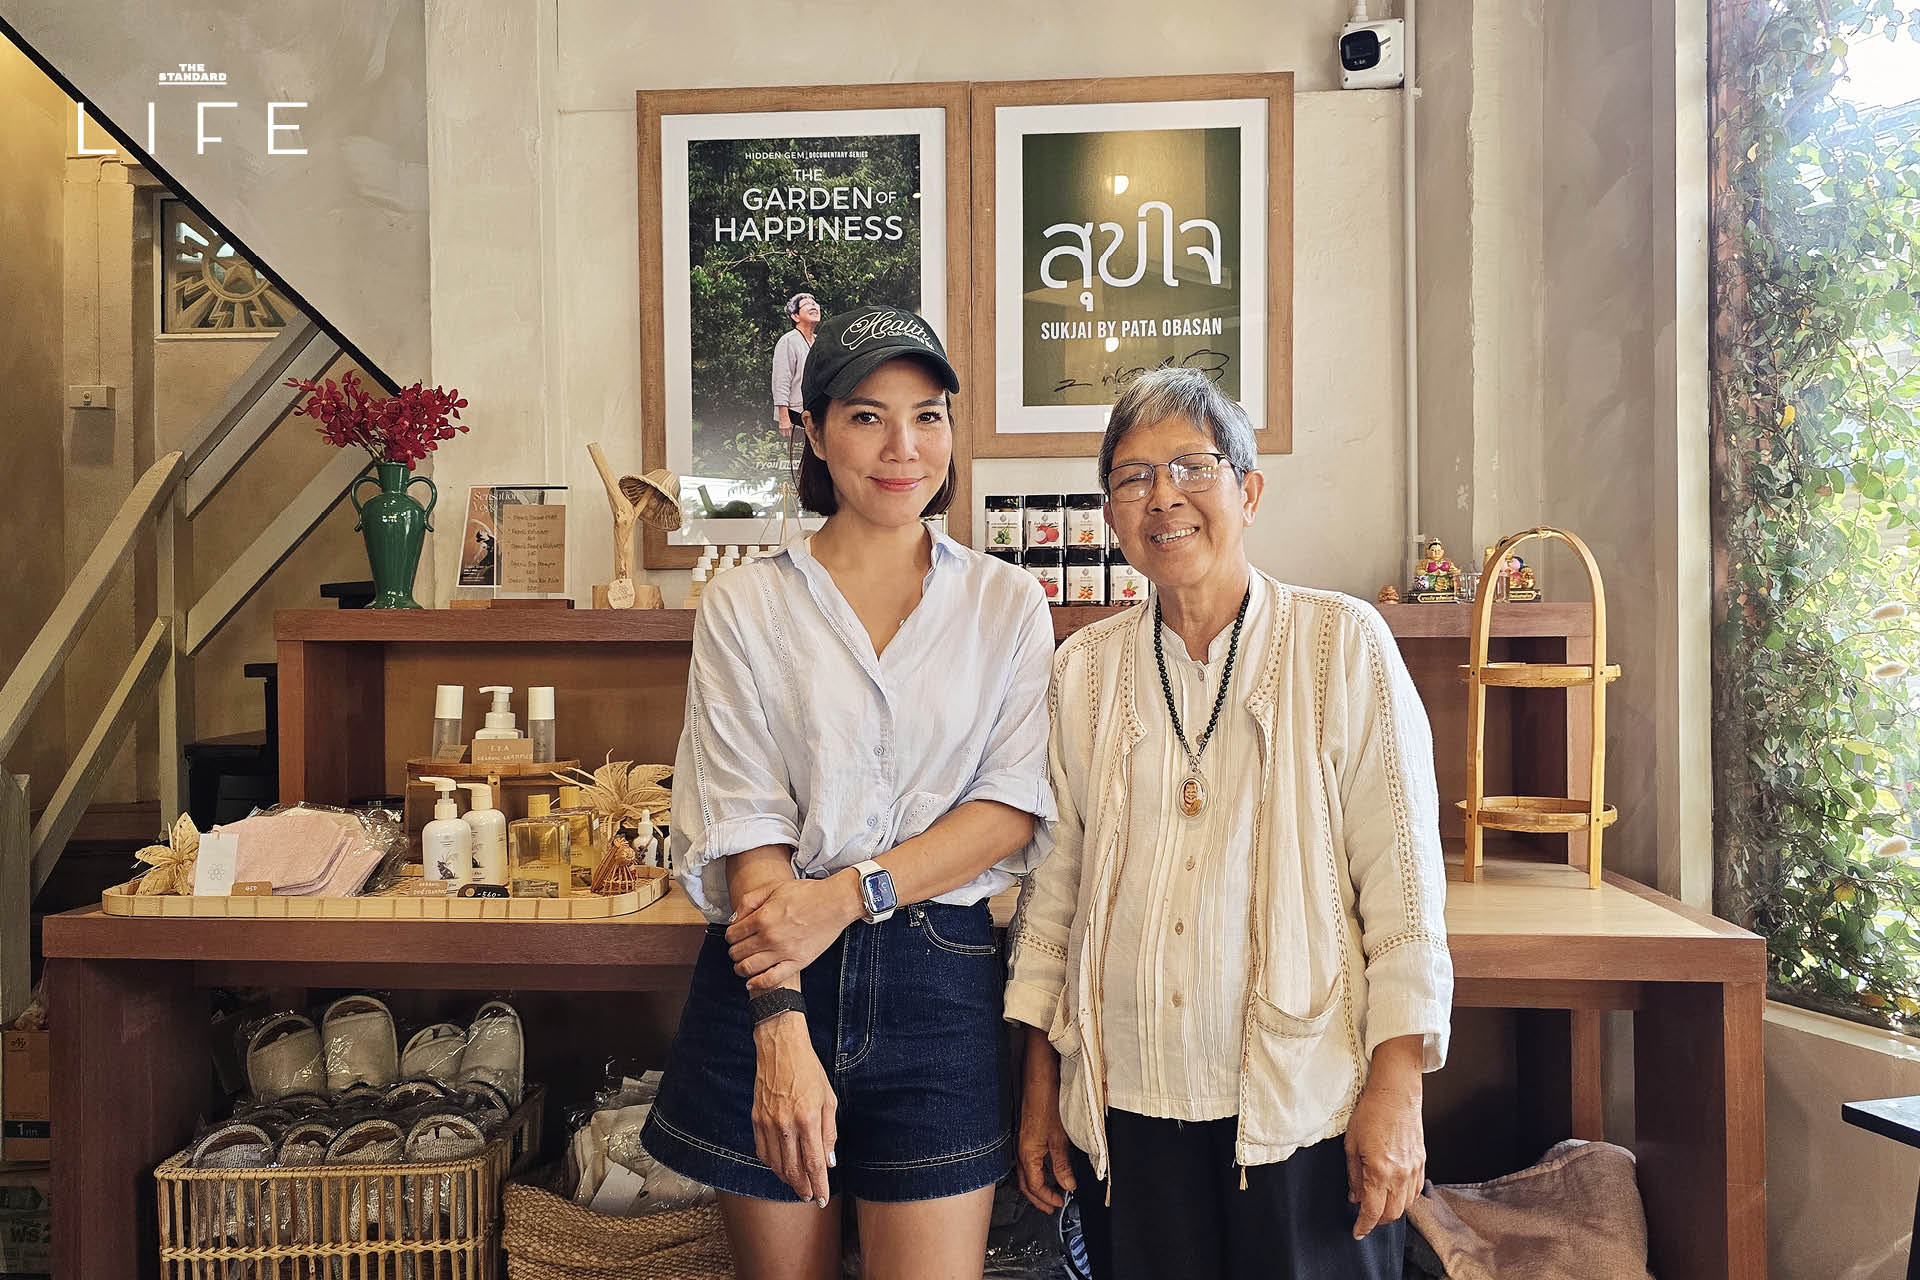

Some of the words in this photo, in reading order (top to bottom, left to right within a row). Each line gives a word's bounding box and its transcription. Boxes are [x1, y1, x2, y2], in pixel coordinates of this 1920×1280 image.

[745, 152, 781, 160] HIDDEN
[784, 151, 804, 159] GEM
[792, 169, 823, 182] THE
[742, 187, 872, 211] GARDEN
[875, 191, 897, 204] OF
[715, 216, 903, 242] HAPPINESS
[1040, 201, 1222, 312] สุขใจ
[841, 311, 930, 350] Health
[1041, 321, 1092, 340] SUKJAI
[1097, 321, 1117, 338] BY
[1121, 319, 1157, 337] PATA
[1162, 317, 1222, 336] OBASAN
